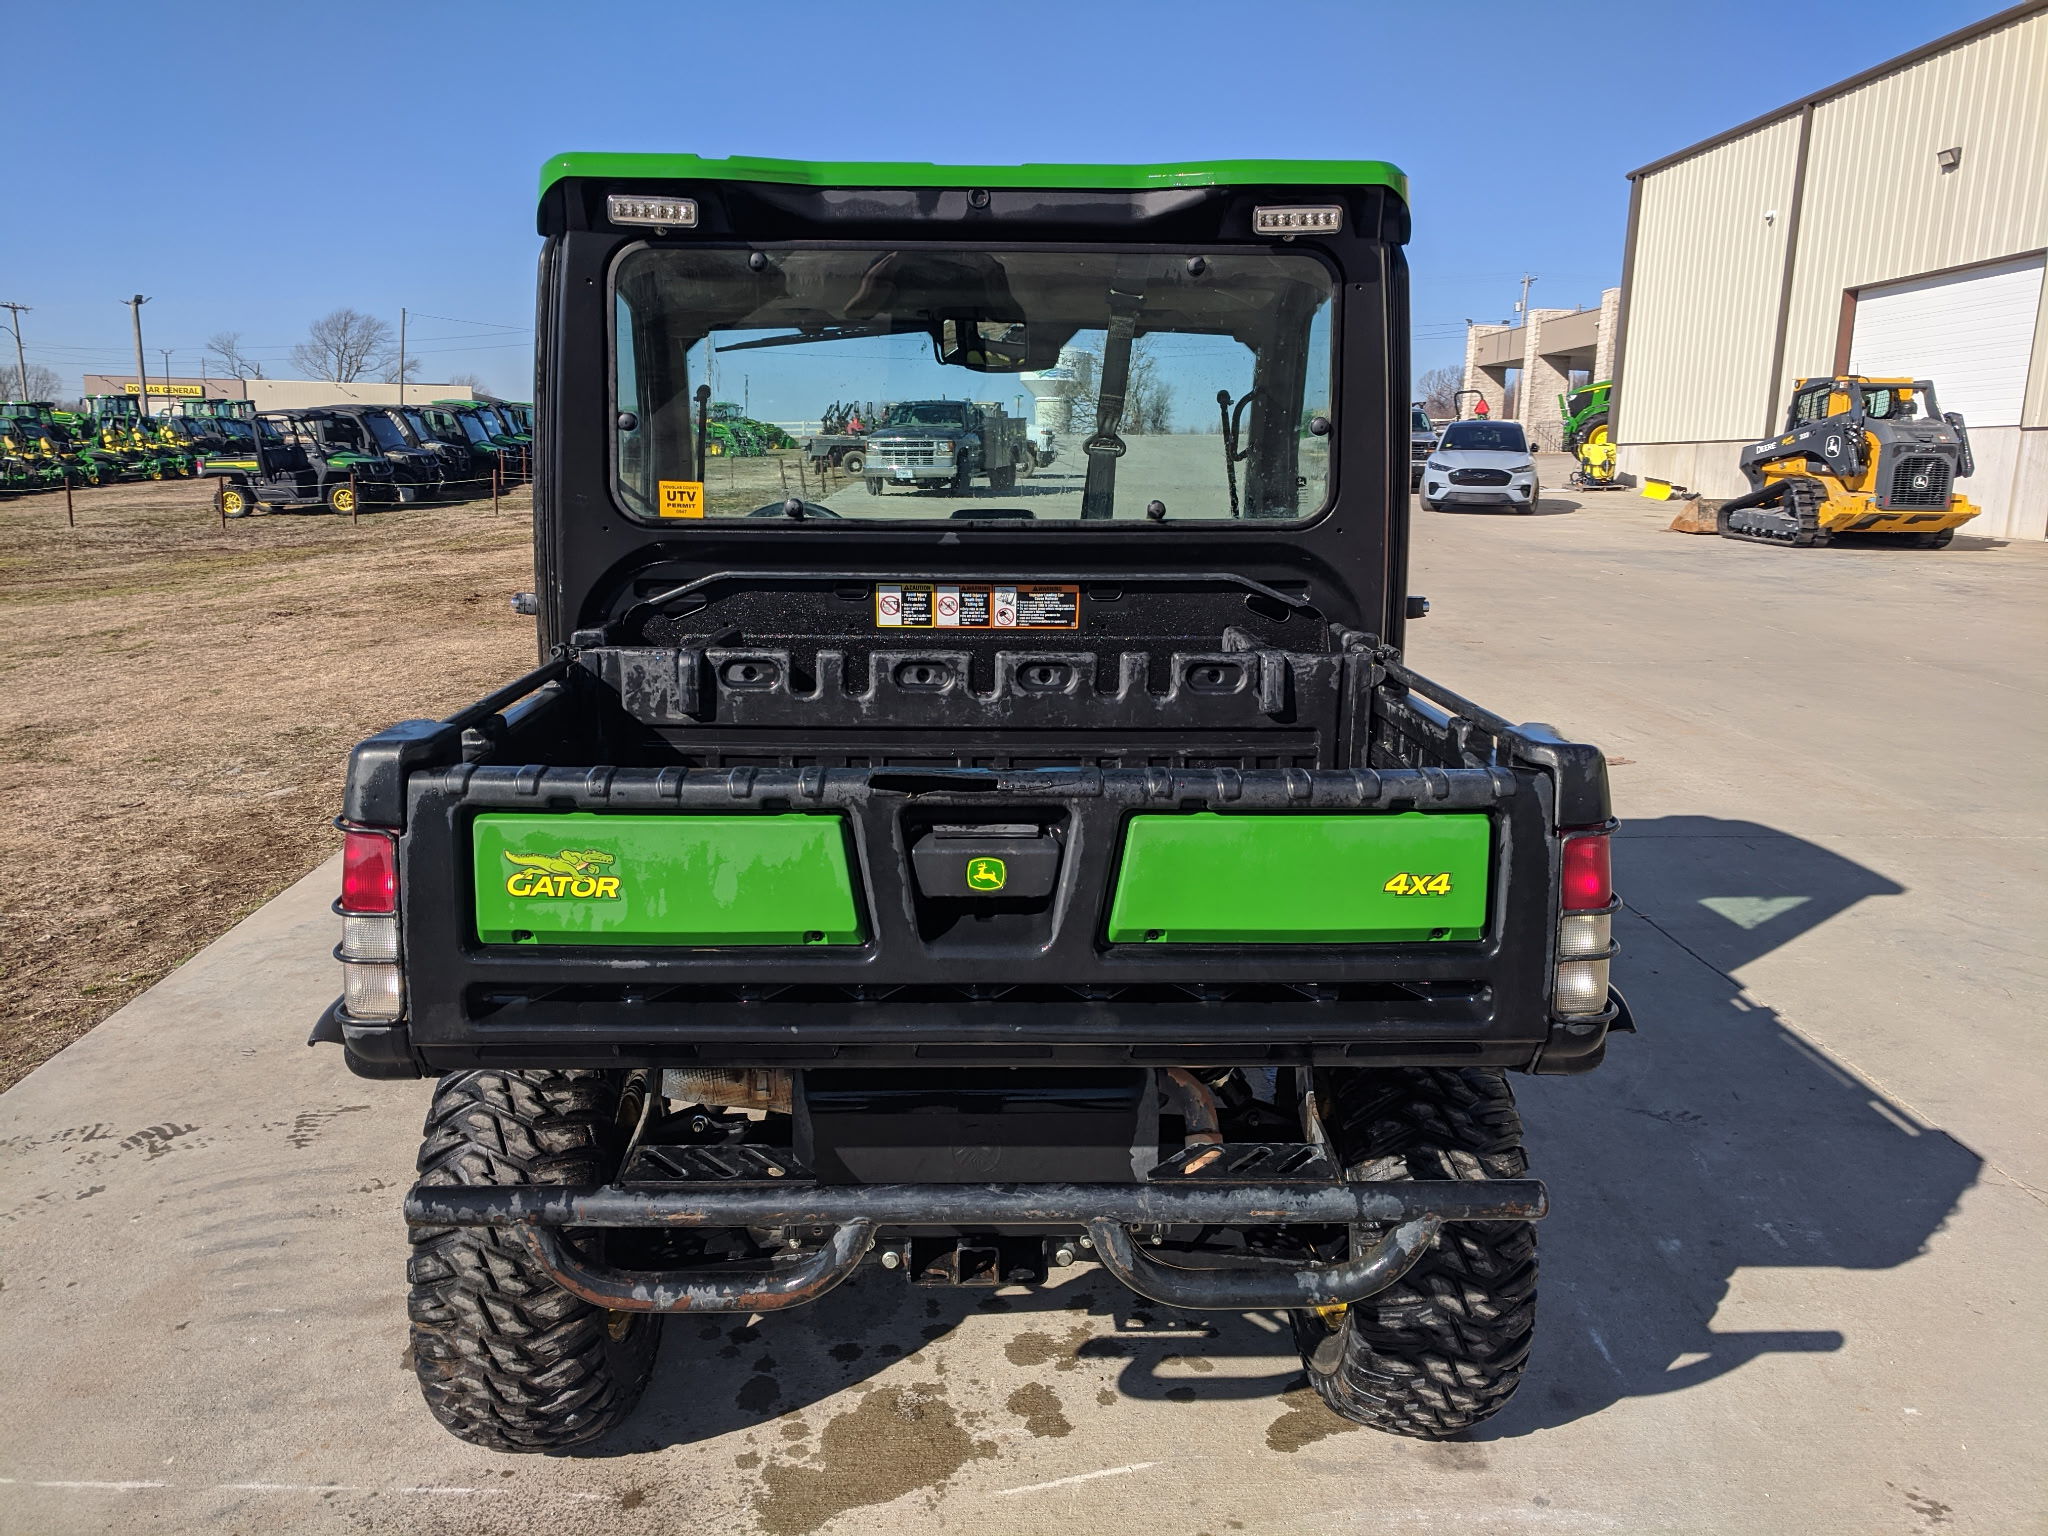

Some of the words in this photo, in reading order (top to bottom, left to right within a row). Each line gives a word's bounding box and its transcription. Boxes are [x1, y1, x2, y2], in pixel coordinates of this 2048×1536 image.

[162, 386, 200, 394] GENERAL
[1756, 442, 1777, 454] DEERE
[667, 490, 696, 501] UTV
[507, 872, 621, 899] GATOR
[1383, 872, 1452, 896] 4x4
